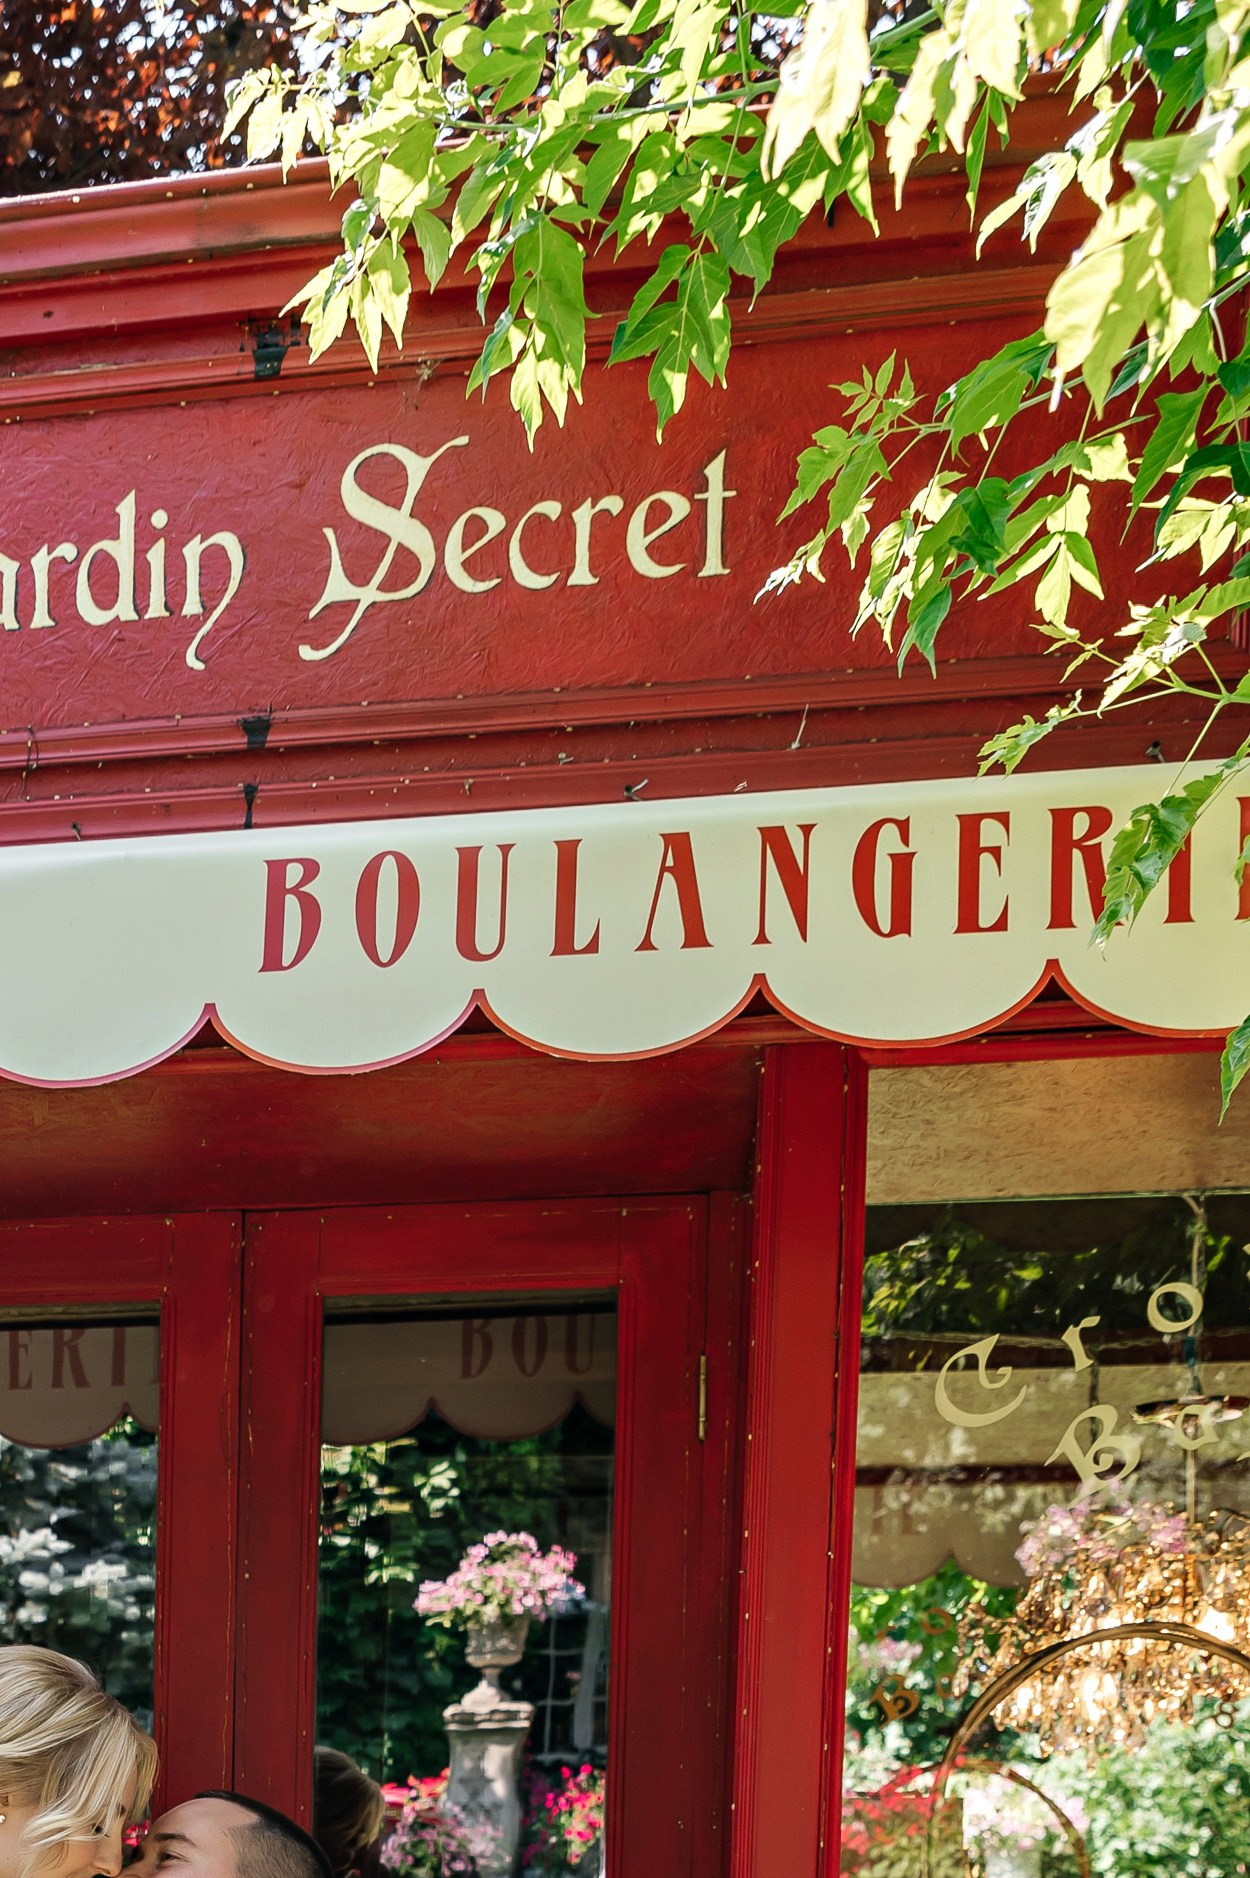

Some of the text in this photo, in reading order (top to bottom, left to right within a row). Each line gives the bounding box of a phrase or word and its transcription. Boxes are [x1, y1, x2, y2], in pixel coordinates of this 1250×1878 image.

[298, 435, 738, 662] Secret
[258, 796, 1250, 974] BOULANGERI
[935, 1243, 1250, 1427] Cro
[1045, 1405, 1250, 1509] Ba
